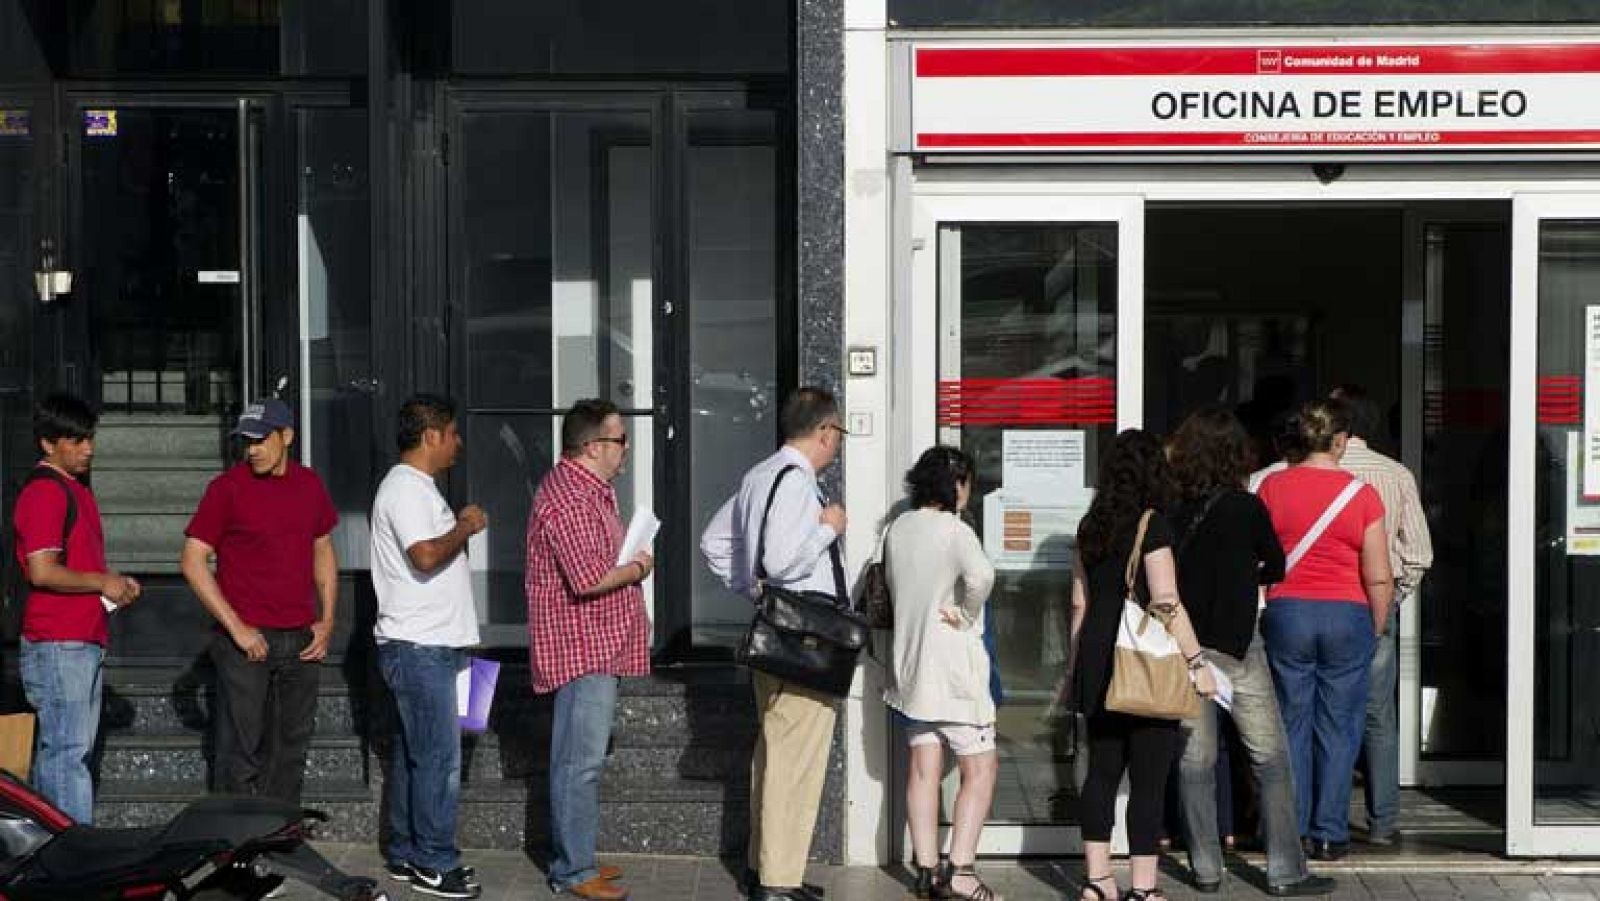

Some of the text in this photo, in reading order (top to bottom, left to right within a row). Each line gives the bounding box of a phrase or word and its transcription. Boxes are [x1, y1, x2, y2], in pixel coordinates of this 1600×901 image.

[1284, 55, 1420, 67] Comunidad de Madrid
[1151, 89, 1528, 119] OFICINA DE EMPLEO
[1310, 132, 1323, 142] DE
[1388, 132, 1395, 142] Y
[1398, 131, 1440, 142] EMPLEO
